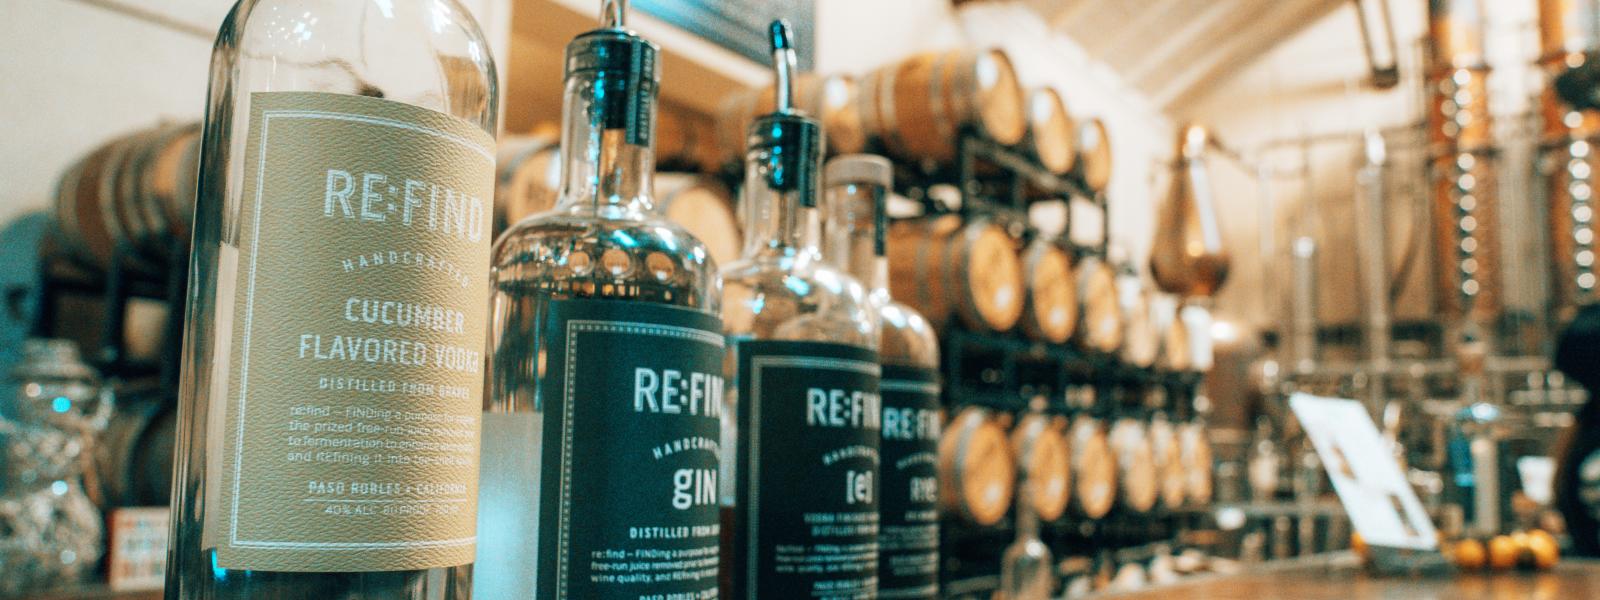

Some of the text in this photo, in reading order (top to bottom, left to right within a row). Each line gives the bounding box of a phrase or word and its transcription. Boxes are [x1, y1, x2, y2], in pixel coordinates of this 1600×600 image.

[324, 168, 484, 243] RE:FIND
[342, 250, 470, 289] HANDCRAFTED
[345, 297, 464, 334] CUCUMBER
[299, 333, 427, 366] FLAVORED
[319, 376, 396, 393] DISTILLED
[633, 367, 724, 419] RE:FIN
[806, 387, 881, 430] RE:FIN
[288, 419, 310, 431] the
[314, 422, 353, 433] prized
[303, 435, 384, 448] fermentation
[287, 451, 312, 462] and
[308, 480, 345, 495] PASO
[351, 481, 400, 496] ROBLES
[672, 468, 717, 511] gIN
[629, 525, 689, 540] DISTILLED
[590, 549, 626, 559] re:find
[635, 549, 671, 560] FINDing
[590, 560, 629, 571] free-run
[629, 562, 651, 572] juice
[590, 573, 616, 583] wine
